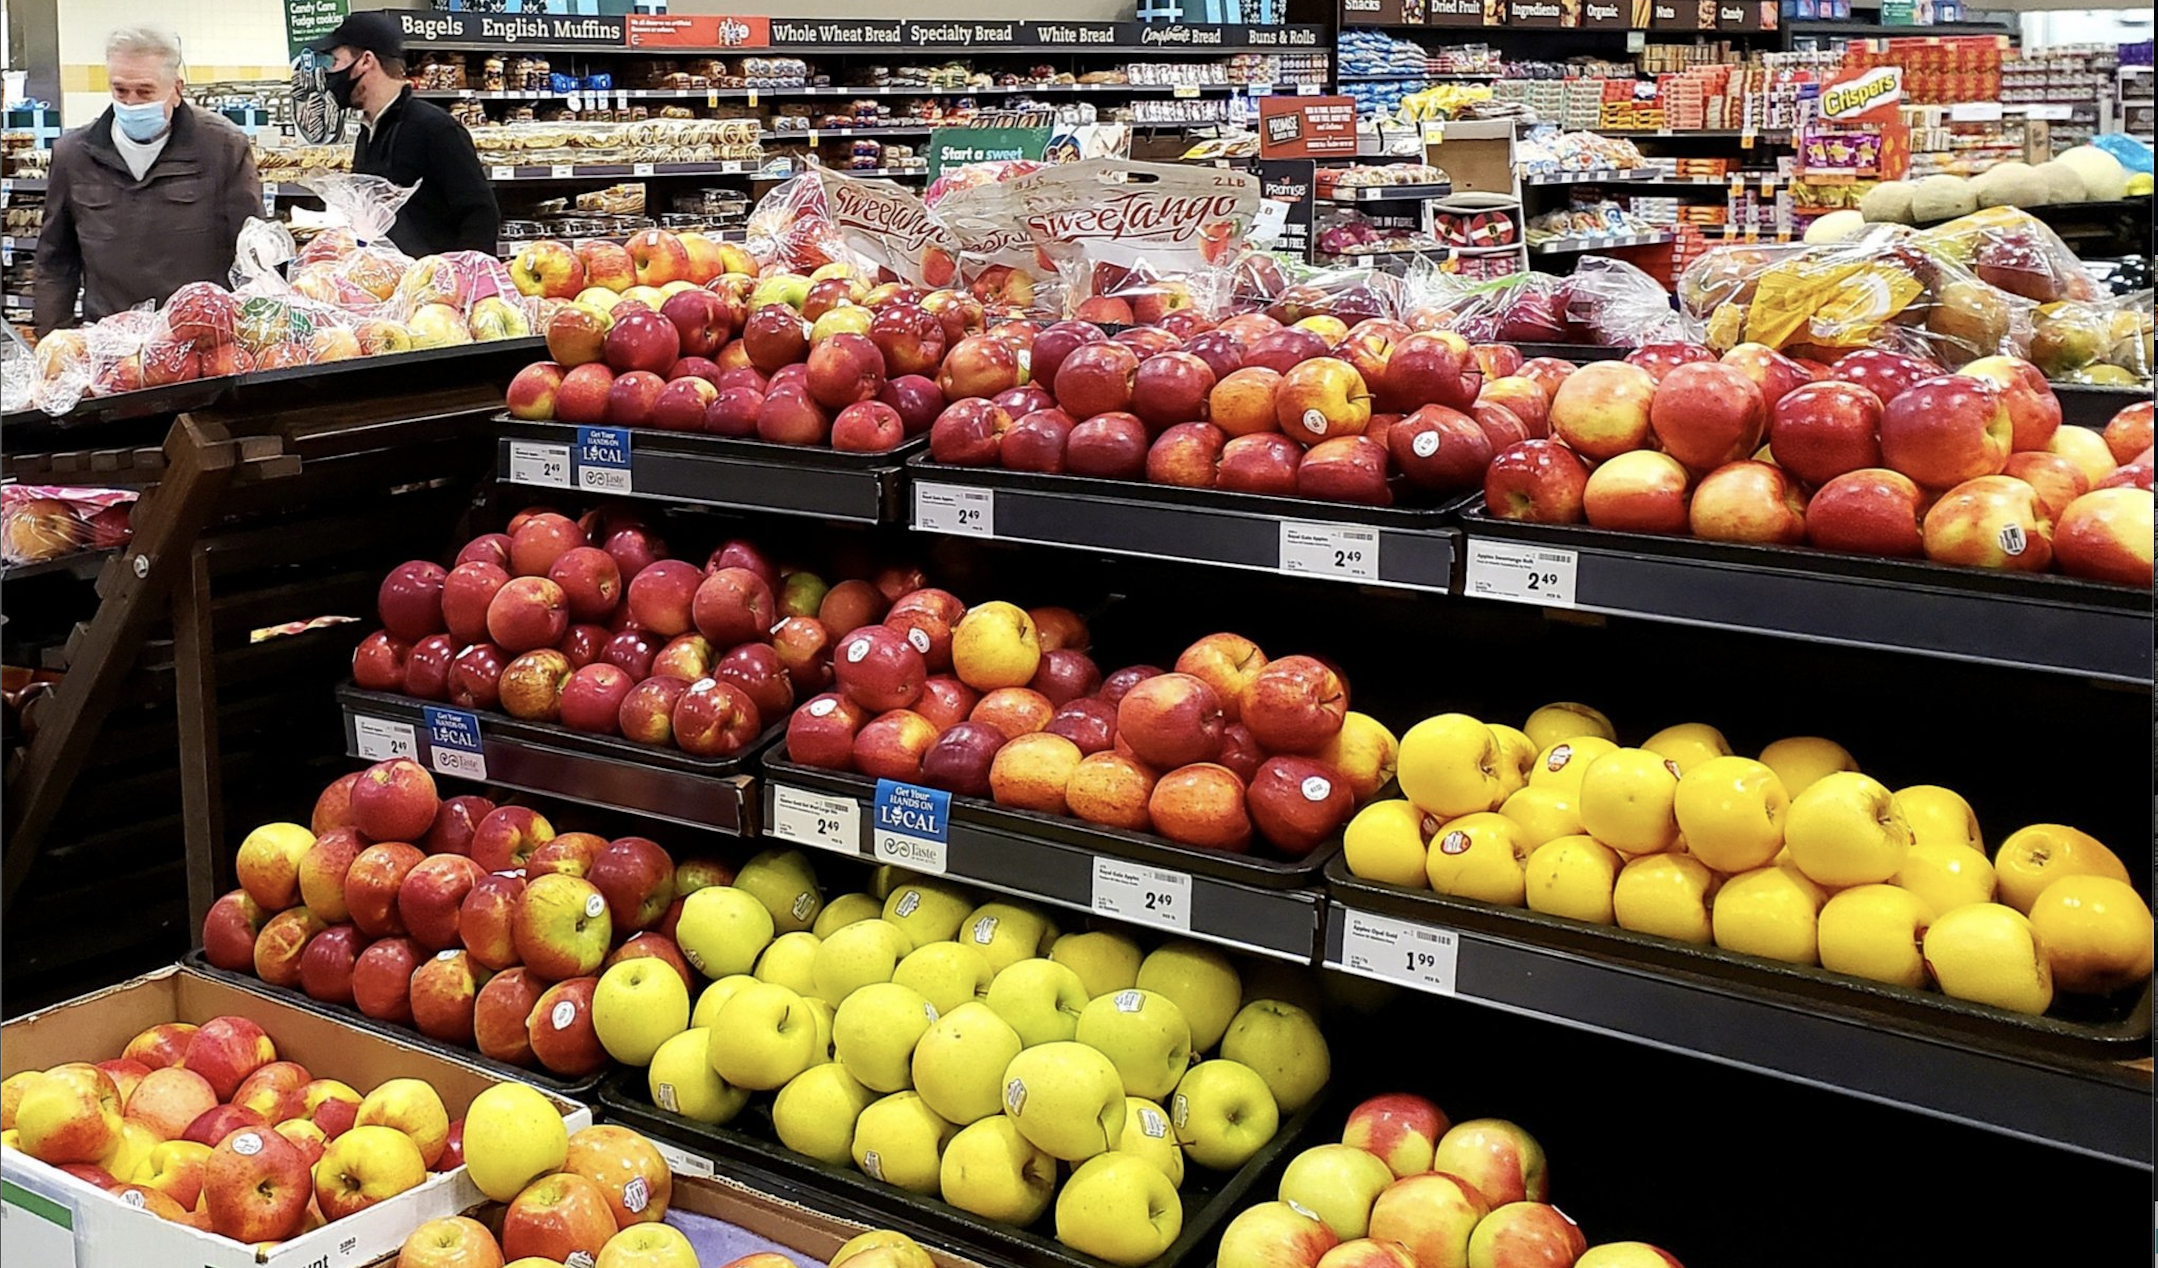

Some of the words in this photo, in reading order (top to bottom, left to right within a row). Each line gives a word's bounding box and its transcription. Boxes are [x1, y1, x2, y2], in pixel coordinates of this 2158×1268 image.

[290, 2, 315, 15] Candy
[316, 1, 337, 12] Cane
[1345, 0, 1381, 11] Snacks
[1431, 0, 1458, 14] Dried
[1459, 0, 1481, 14] Fruit
[1512, 3, 1560, 19] Ingredients
[1587, 4, 1618, 20] Organic
[1656, 5, 1675, 18] Nuts
[291, 14, 315, 28] Fudge
[316, 14, 344, 25] cookies
[1721, 6, 1744, 23] Candy
[401, 15, 464, 40] Bagels
[482, 18, 549, 42] English
[553, 20, 620, 39] Muffins
[772, 25, 816, 41] Whole
[819, 25, 862, 42] Wheat
[865, 26, 901, 43] Bread
[911, 25, 972, 45] Specialty
[974, 25, 1012, 41] Bread
[1037, 27, 1076, 43] White
[1079, 27, 1114, 43] Bread
[1192, 28, 1221, 44] Bread
[1248, 30, 1277, 44] Buns
[1279, 30, 1288, 44] &
[1290, 29, 1316, 44] Rolls
[1824, 74, 1897, 117] Crispers
[940, 146, 972, 160] Start
[974, 150, 983, 160] a
[985, 147, 1023, 160] sweet
[1213, 177, 1222, 186] 2
[1227, 177, 1246, 187] LB
[895, 786, 909, 796] Get
[910, 789, 930, 800] Your
[889, 794, 919, 808] HANDS
[920, 801, 934, 811] ON
[909, 842, 937, 860] Taste
